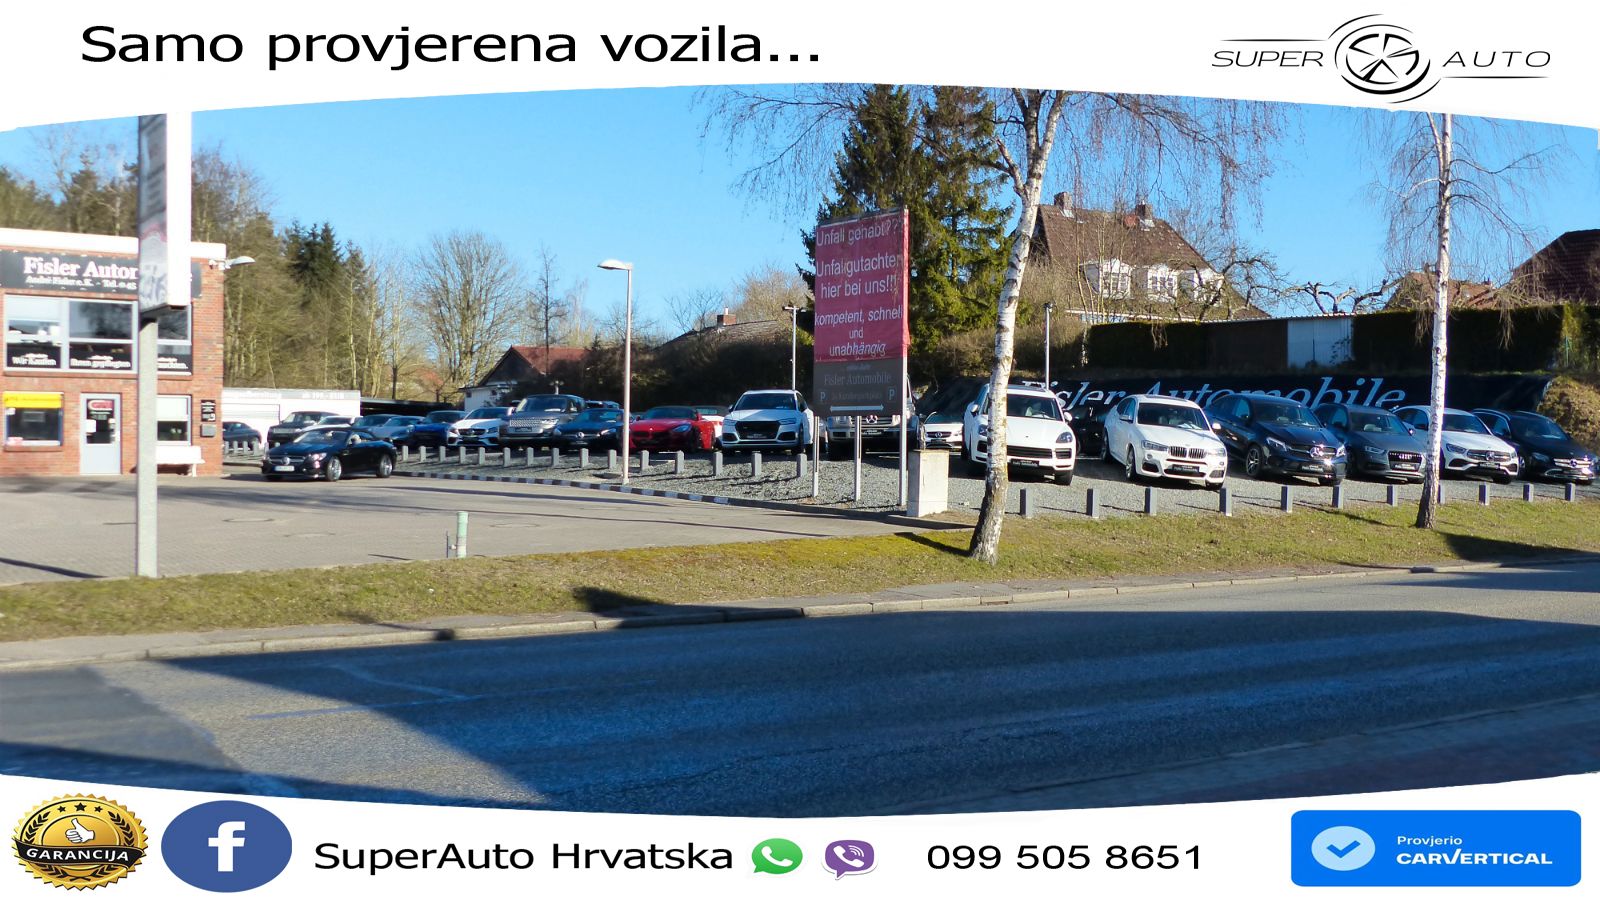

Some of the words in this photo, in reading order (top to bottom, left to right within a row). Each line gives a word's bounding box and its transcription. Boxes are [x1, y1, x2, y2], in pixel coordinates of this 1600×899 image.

[816, 229, 845, 246] Unfall
[23, 256, 80, 276] Fisler
[820, 282, 841, 299] hier
[844, 278, 861, 297] bei
[815, 309, 865, 327] kompetent,
[867, 304, 903, 322] schnell
[849, 327, 864, 339] und
[829, 340, 886, 358] unabhängig
